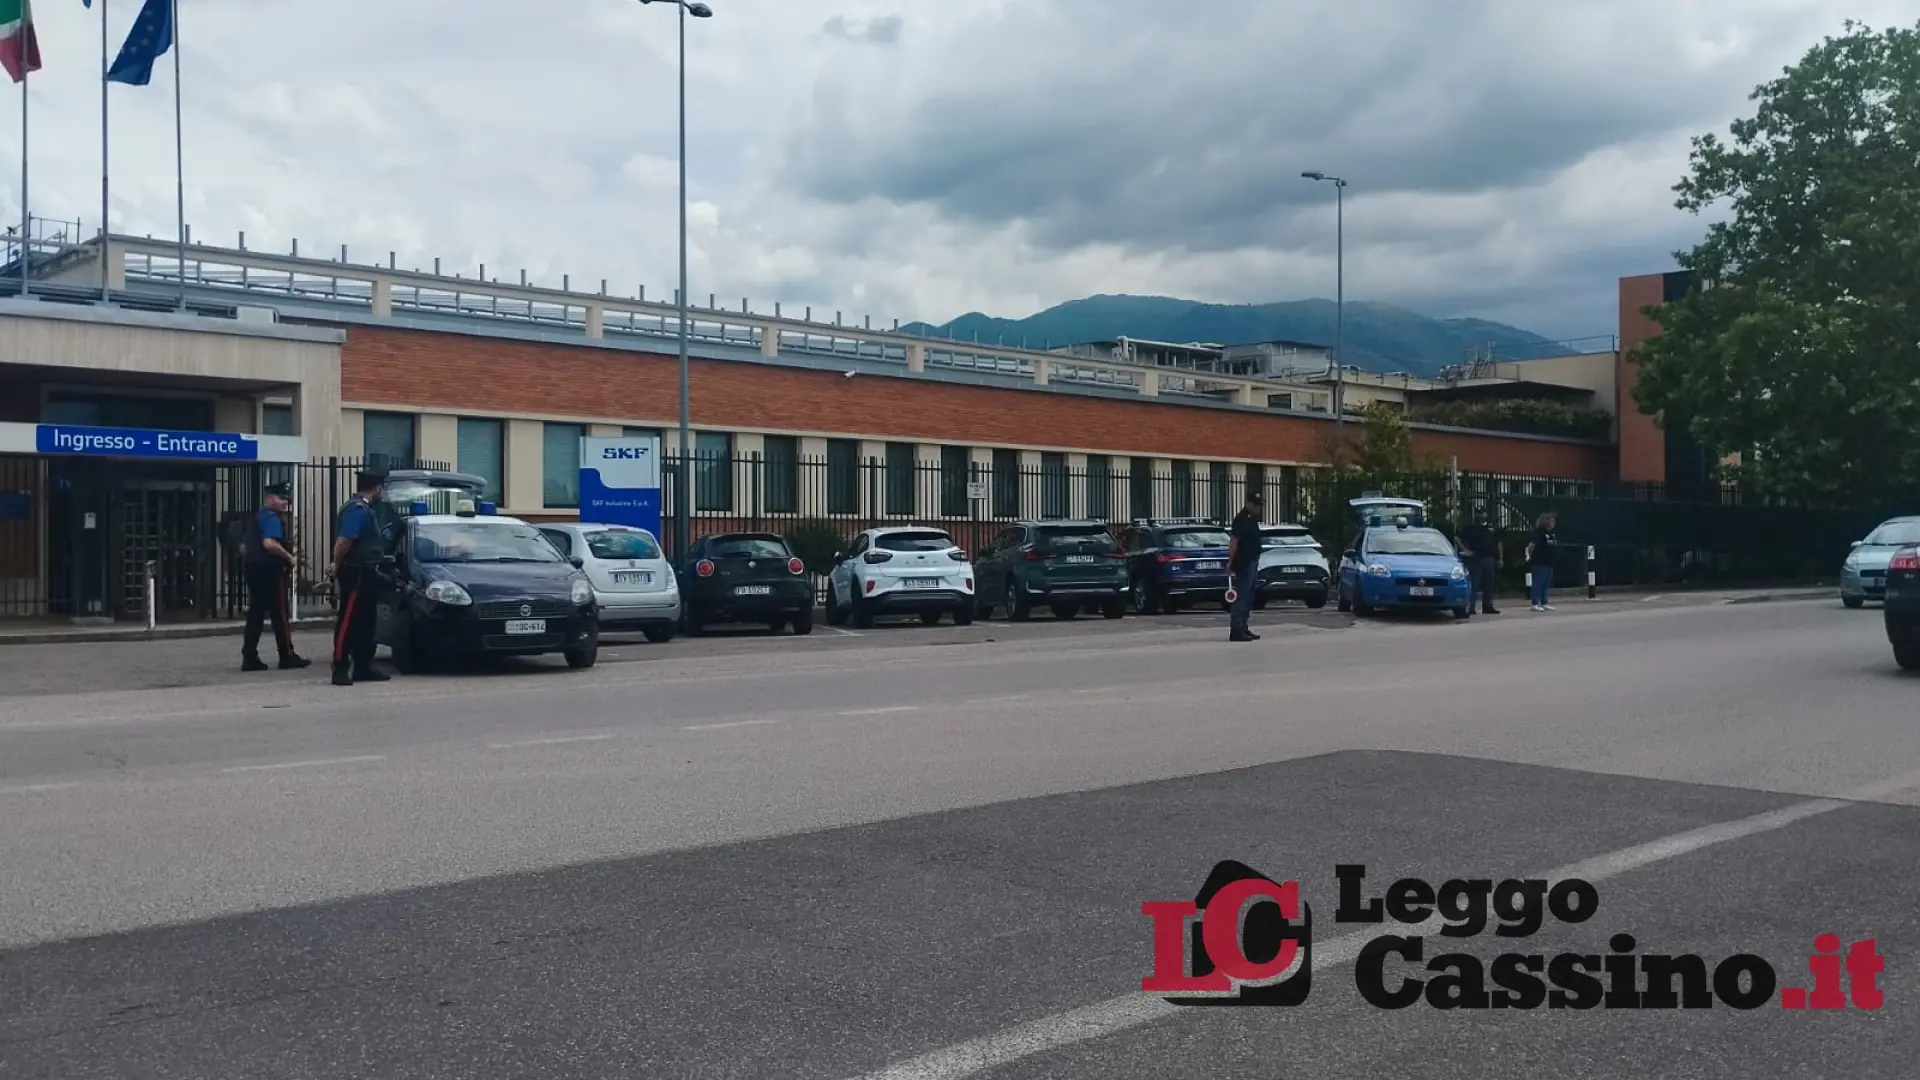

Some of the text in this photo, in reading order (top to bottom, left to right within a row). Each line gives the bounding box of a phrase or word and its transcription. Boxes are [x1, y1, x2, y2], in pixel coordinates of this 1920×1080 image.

[54, 429, 135, 451] Ingresso
[157, 433, 238, 454] Entrance
[603, 448, 649, 459] SKF
